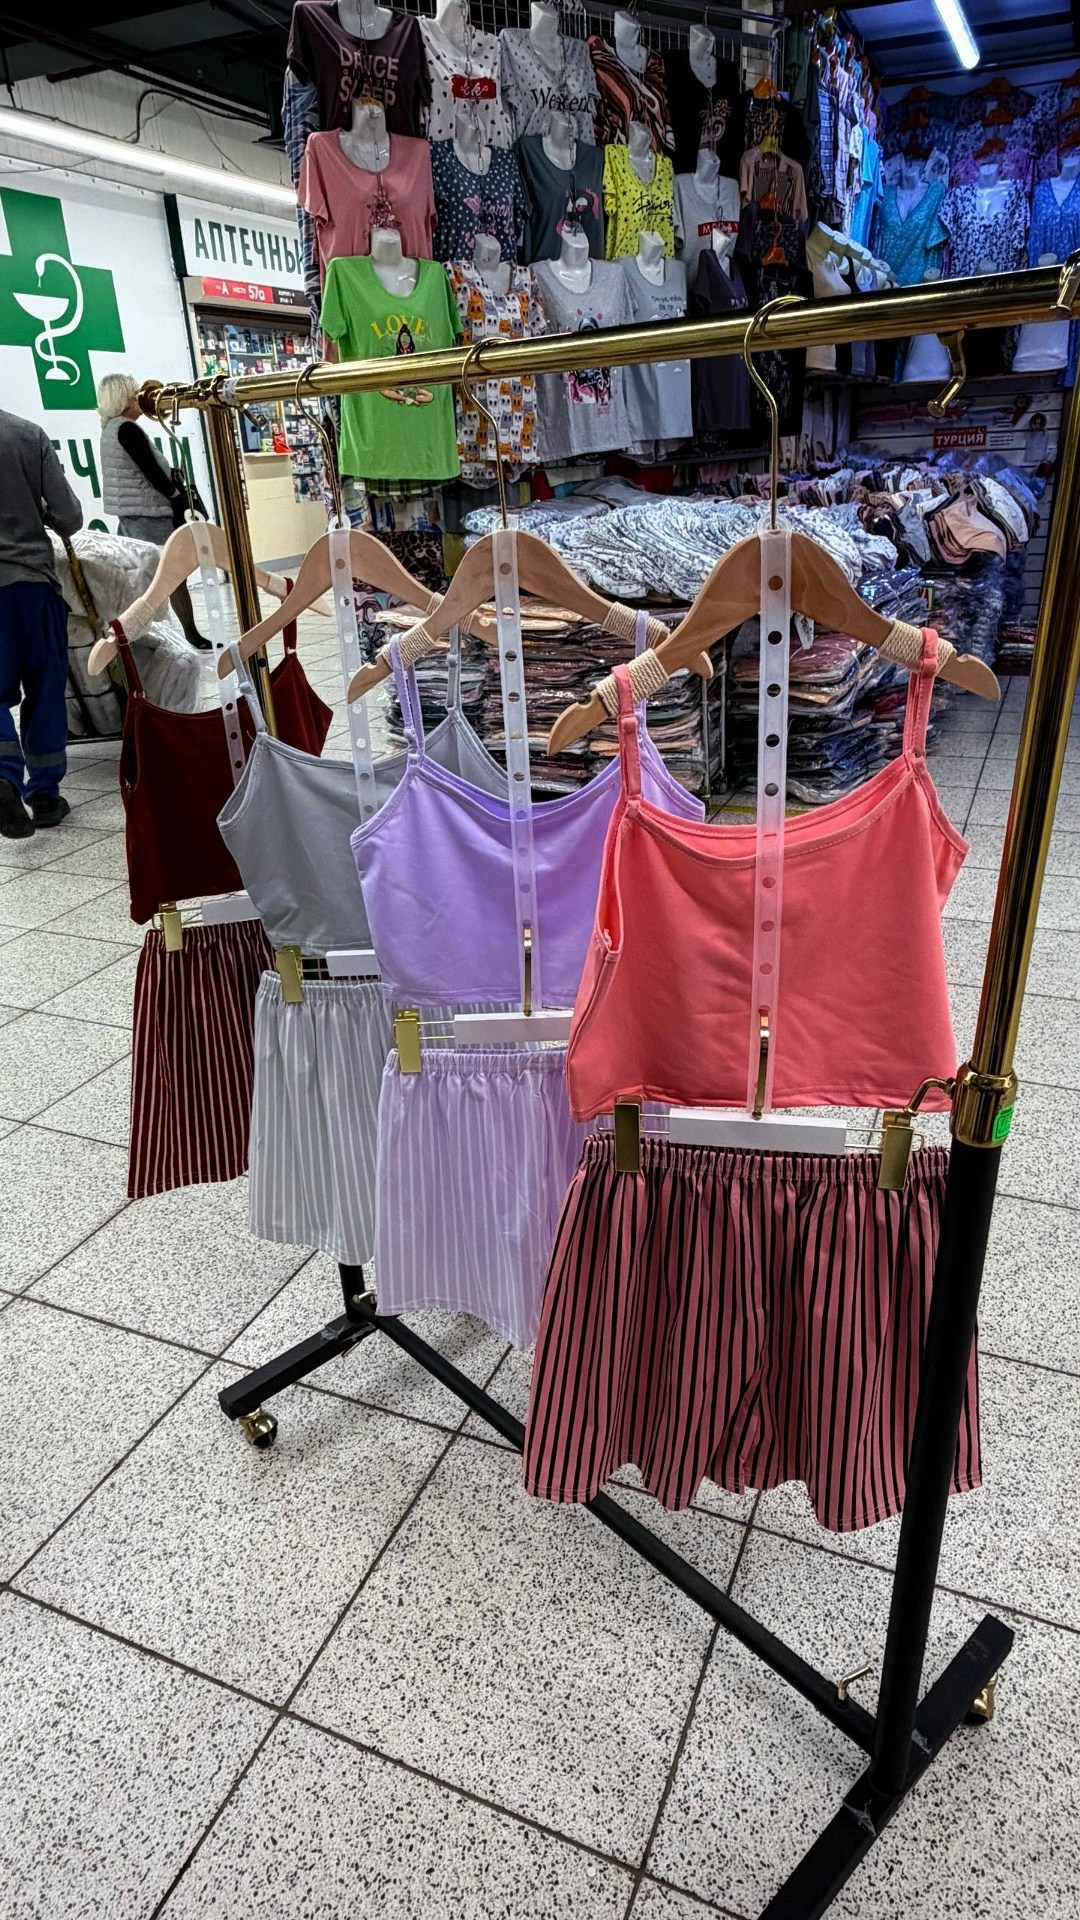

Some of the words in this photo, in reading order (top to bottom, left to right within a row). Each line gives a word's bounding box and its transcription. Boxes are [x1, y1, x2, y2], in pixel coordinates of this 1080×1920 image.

[340, 47, 399, 80] DANCE
[371, 315, 425, 339] LOVE
[936, 433, 984, 446] ТУРЦИЯ
